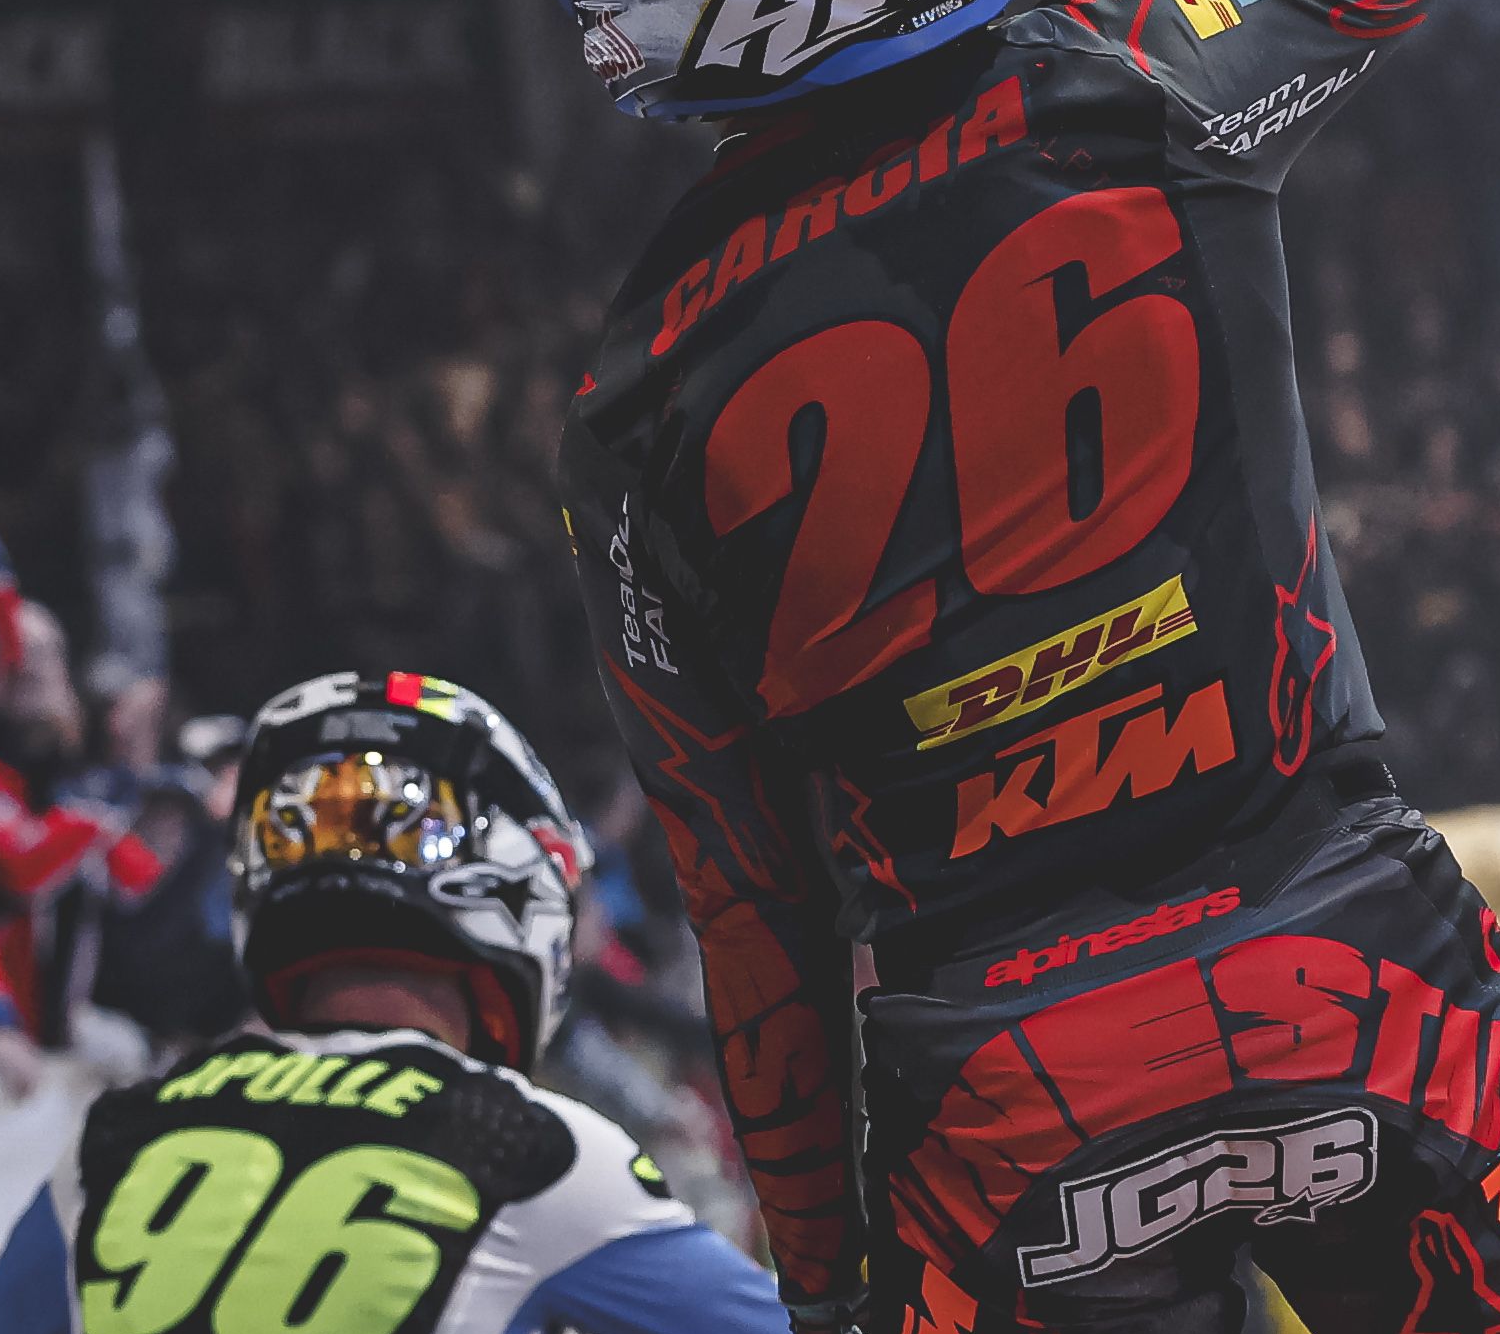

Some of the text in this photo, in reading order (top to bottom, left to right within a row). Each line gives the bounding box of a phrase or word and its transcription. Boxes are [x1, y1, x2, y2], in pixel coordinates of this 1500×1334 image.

[1202, 73, 1308, 136] Team
[704, 185, 1202, 720] 26
[947, 605, 1158, 734] DHL
[950, 679, 1236, 860] KTM
[984, 885, 1241, 988] alpinestars
[156, 1049, 444, 1118] APOLLE
[1022, 1107, 1376, 1287] JG26
